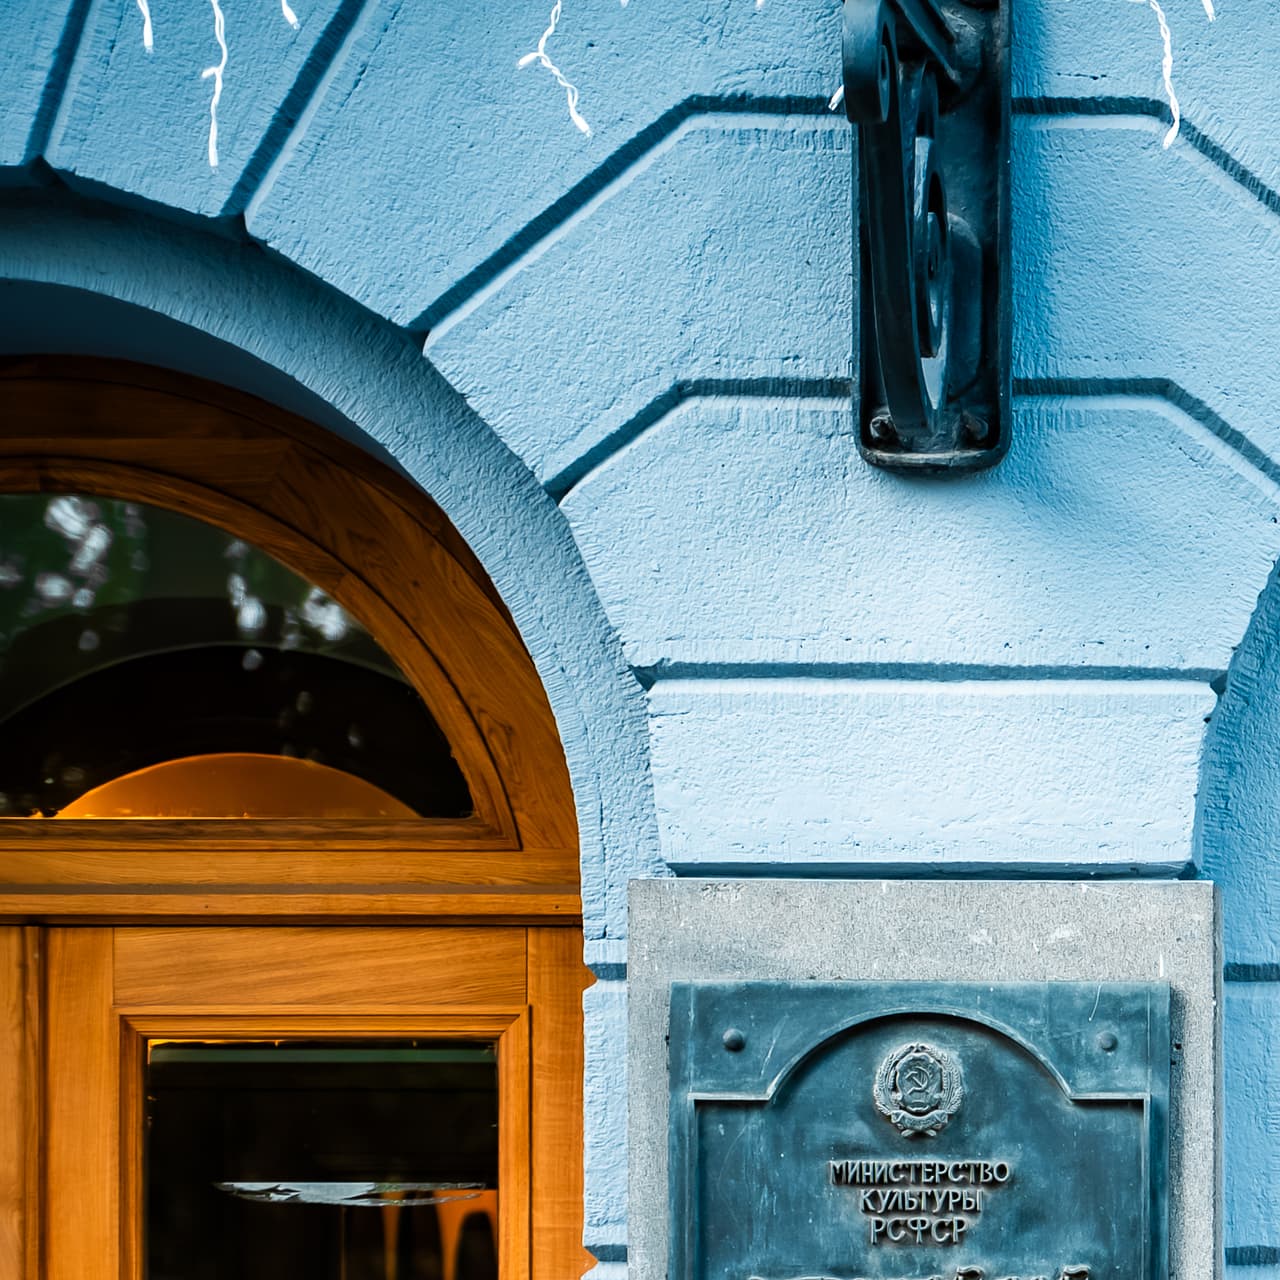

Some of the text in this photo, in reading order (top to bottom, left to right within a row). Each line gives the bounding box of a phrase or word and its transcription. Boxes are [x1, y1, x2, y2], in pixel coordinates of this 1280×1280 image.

[829, 1160, 1010, 1185] МИНИСТЕРСТВО
[860, 1188, 984, 1214] КУЛЬТУРЫ
[870, 1216, 967, 1244] РСФСР
